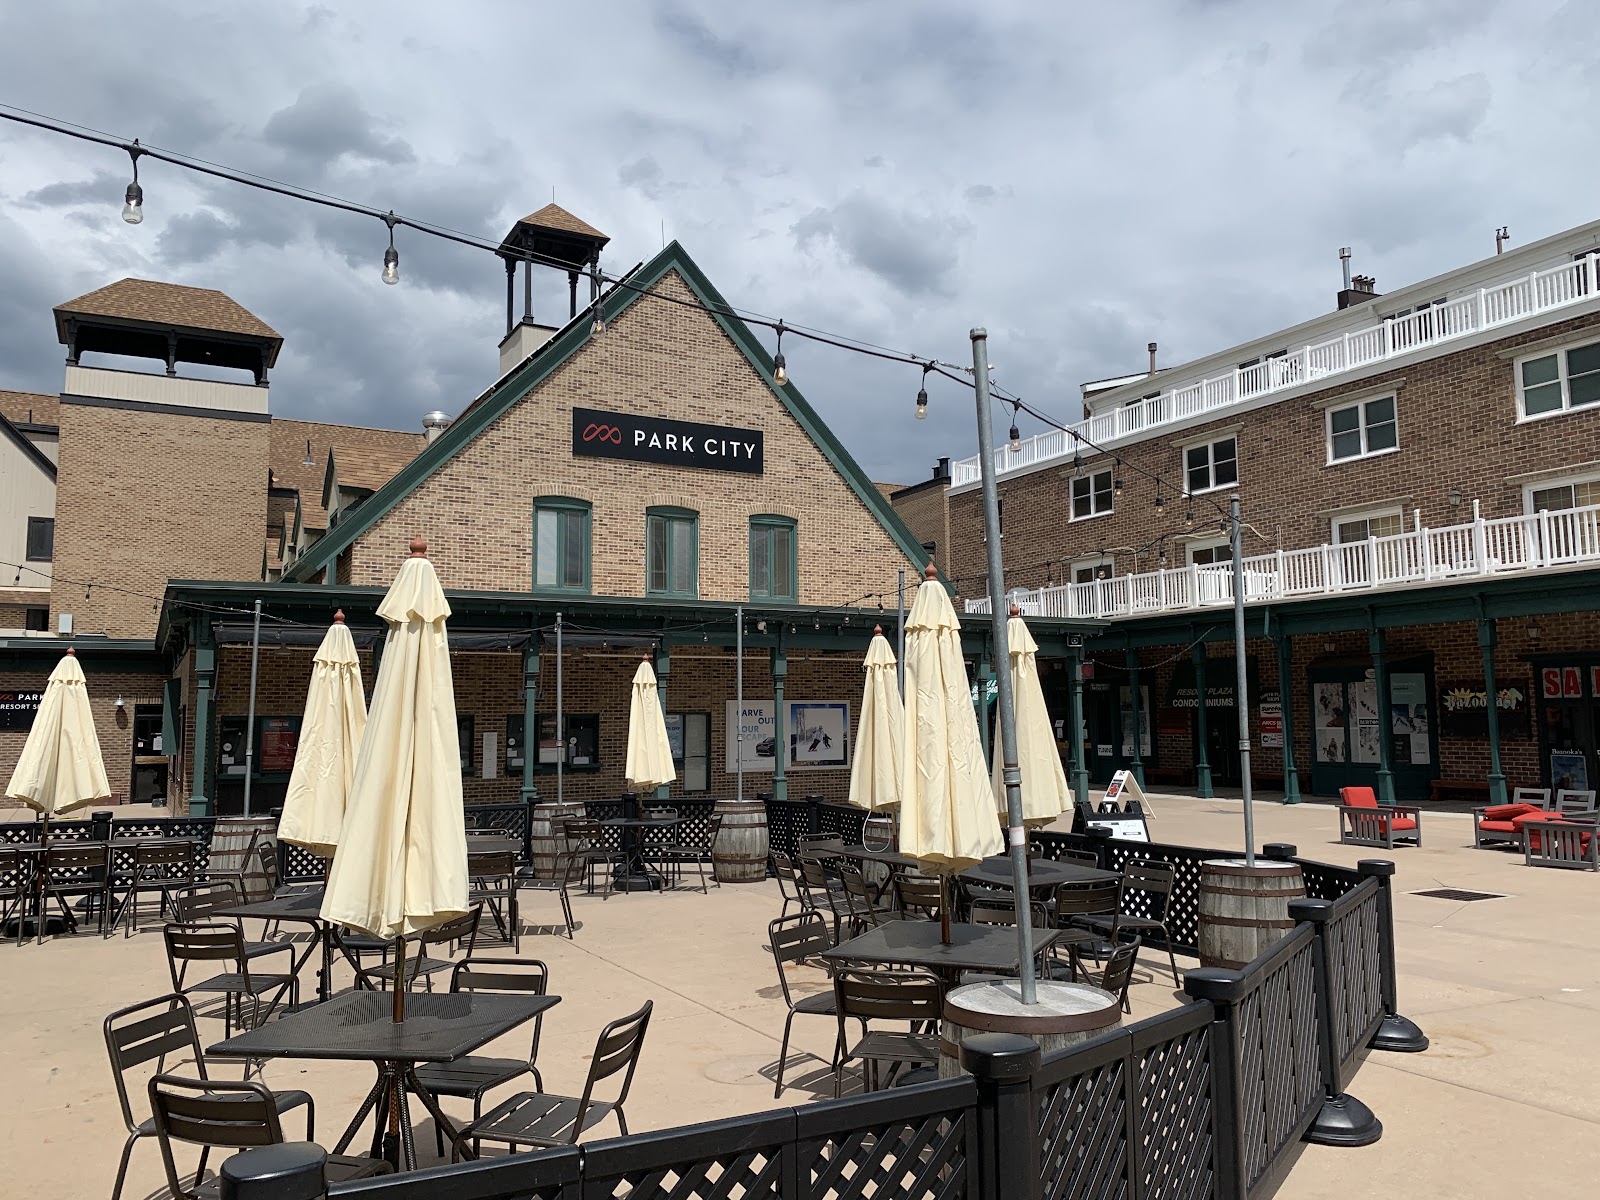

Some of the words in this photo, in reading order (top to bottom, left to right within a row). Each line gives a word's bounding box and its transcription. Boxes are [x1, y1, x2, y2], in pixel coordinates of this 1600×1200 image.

[634, 429, 695, 453] PARK
[704, 438, 756, 459] CITY
[1176, 688, 1207, 696] RESO
[1207, 687, 1233, 695] PLAZA
[1172, 698, 1234, 708] CONDOINIUMS
[758, 717, 776, 725] OUT
